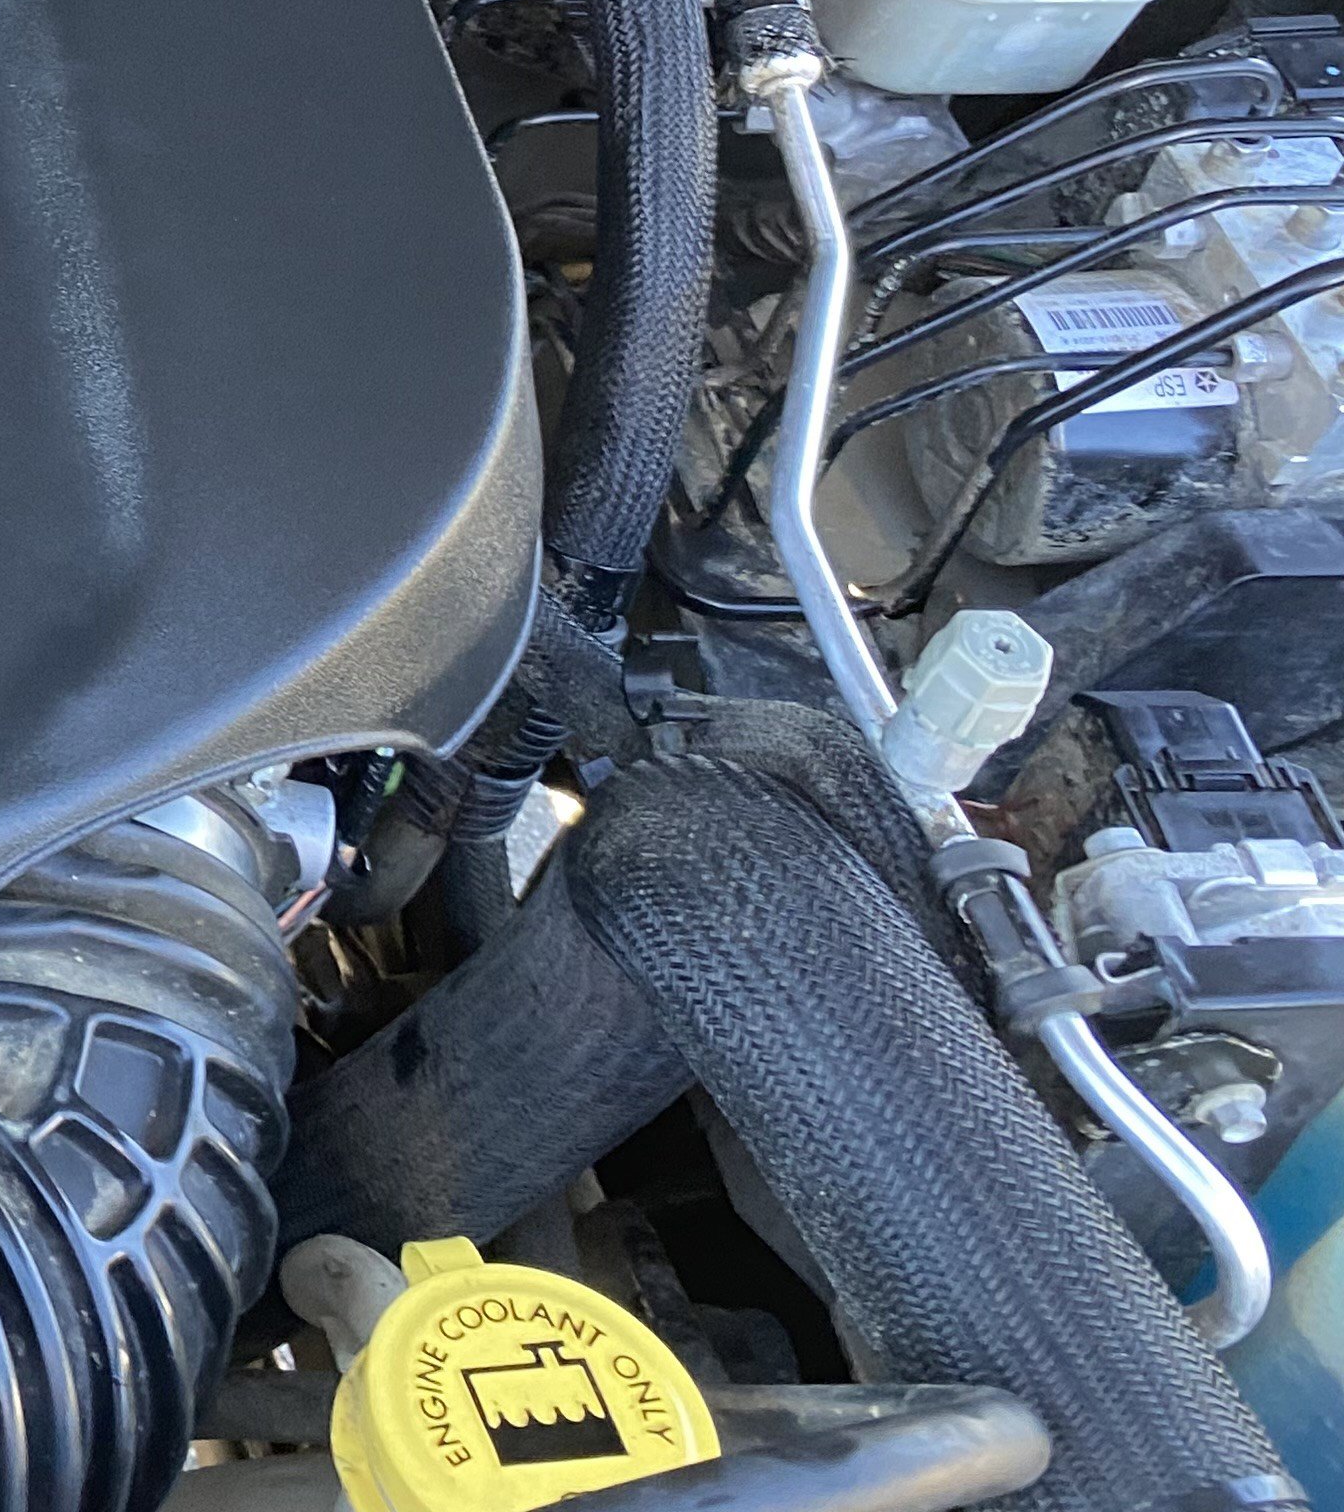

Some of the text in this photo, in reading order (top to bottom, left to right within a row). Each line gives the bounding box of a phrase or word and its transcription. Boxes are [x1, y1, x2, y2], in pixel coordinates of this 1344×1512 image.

[1153, 373, 1188, 398] ESP
[415, 1298, 676, 1468] ENGINE COOLANT ONLY
